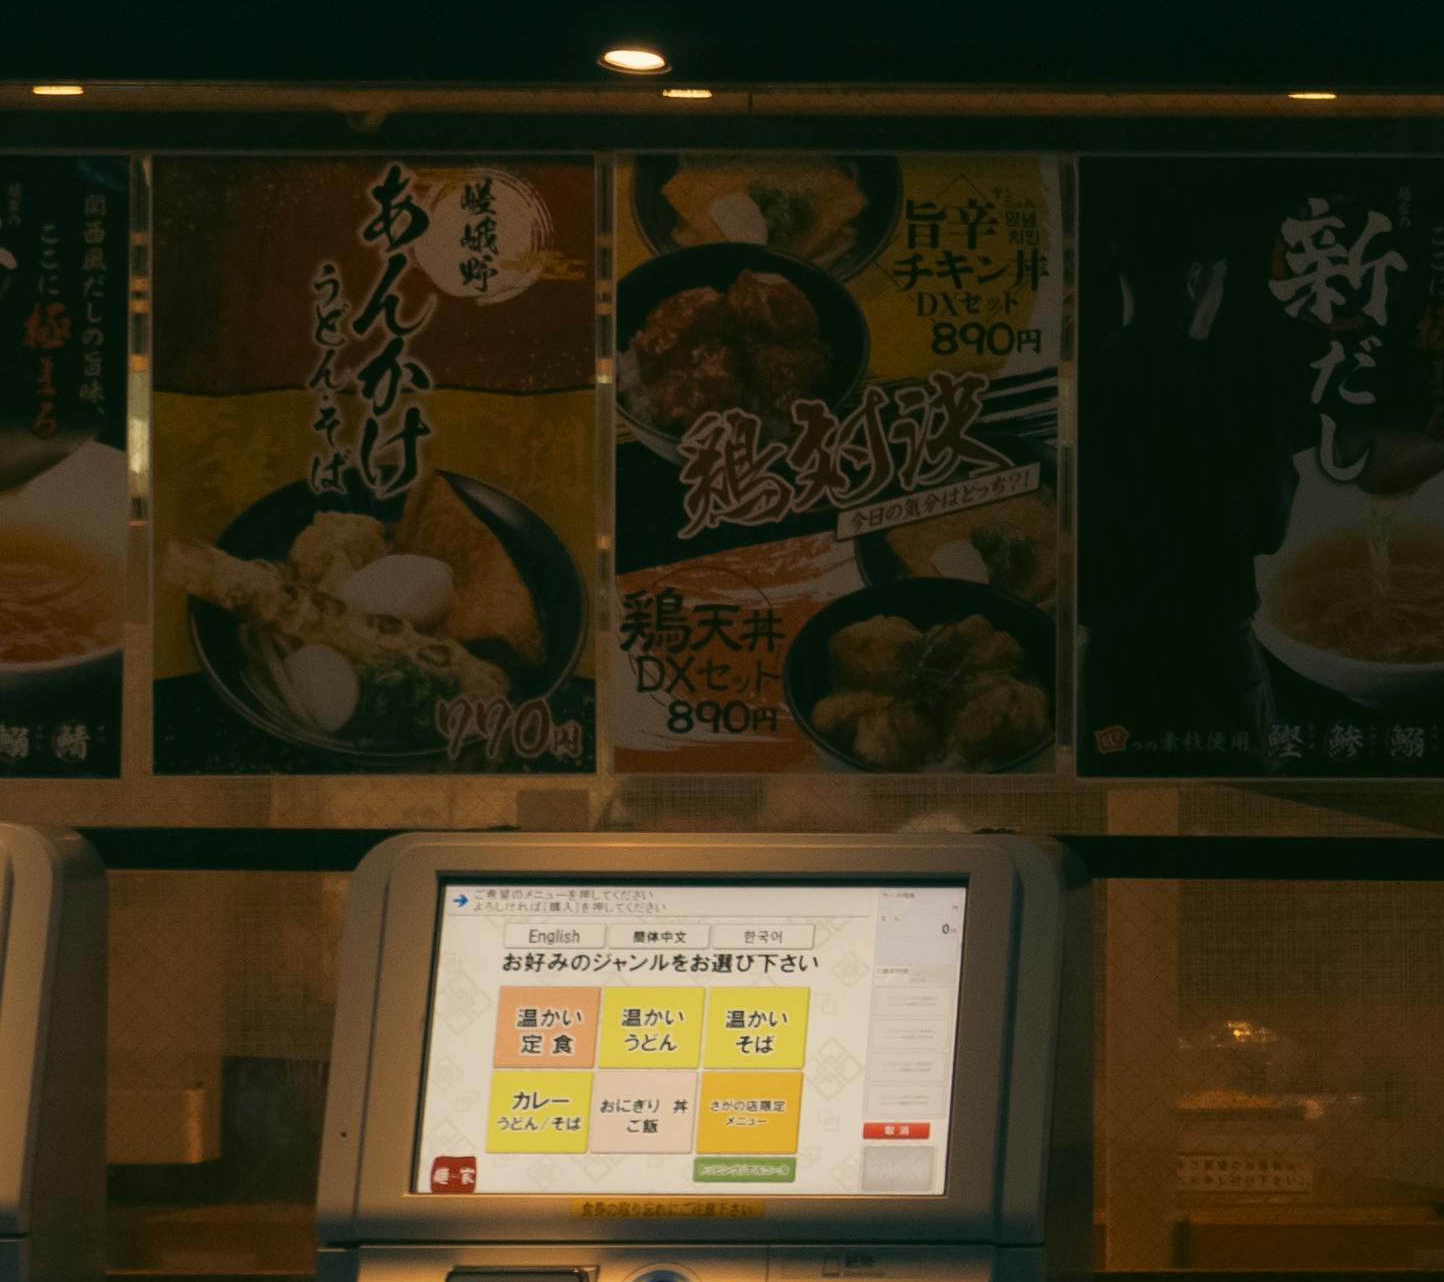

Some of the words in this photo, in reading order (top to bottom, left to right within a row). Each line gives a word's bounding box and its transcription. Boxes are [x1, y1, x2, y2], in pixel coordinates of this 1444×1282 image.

[459, 178, 499, 292] 嵯峨野
[904, 197, 1000, 250] 旨辛
[893, 251, 1049, 293] チキン丼
[915, 291, 1019, 318] DXセット
[352, 163, 438, 497] あんかけ
[931, 320, 1043, 357] 890円
[1268, 196, 1409, 483] 新だし
[309, 262, 350, 495] うどん・そば
[621, 588, 786, 654] 鶏天丼
[636, 657, 780, 696] DXセット
[434, 698, 585, 759] 770円
[667, 700, 778, 735] 890円
[528, 928, 580, 947] English
[743, 929, 783, 945] 한국어
[503, 952, 820, 975] お好みのジャンルをお選び下さい
[517, 1008, 583, 1029] 温かい
[621, 1008, 684, 1029] 温かい
[725, 1008, 789, 1029] 温かい
[623, 1034, 678, 1053] うどん
[735, 1034, 774, 1054] そば
[512, 1091, 570, 1112] カレー
[599, 1097, 660, 1114] おにぎり
[673, 1098, 689, 1114] 丼
[626, 1118, 659, 1135] ご飯
